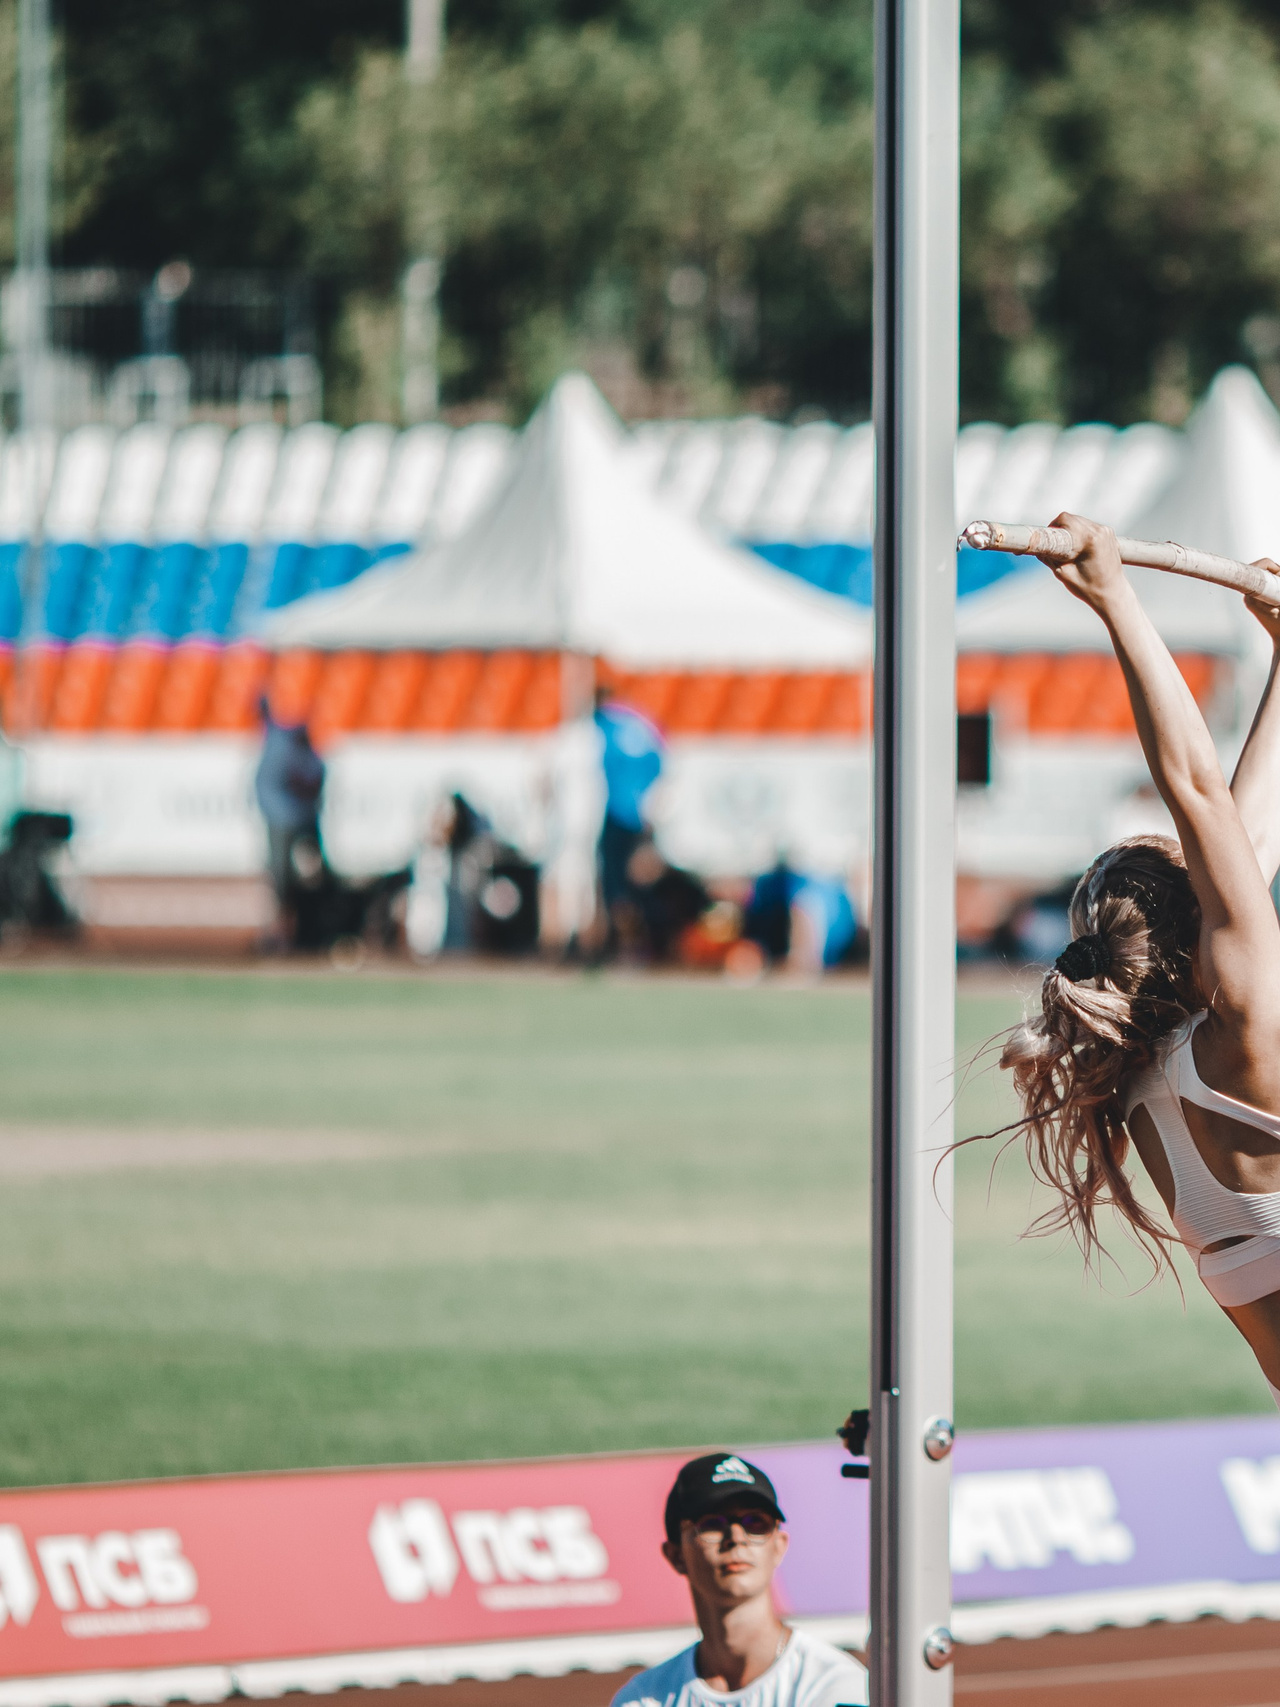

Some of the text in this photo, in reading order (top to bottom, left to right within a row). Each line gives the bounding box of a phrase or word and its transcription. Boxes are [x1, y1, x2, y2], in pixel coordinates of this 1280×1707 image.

[452, 1505, 608, 1583] ПСБ
[949, 1466, 1134, 1573] АТЧ!
[37, 1528, 198, 1611] ПСБ
